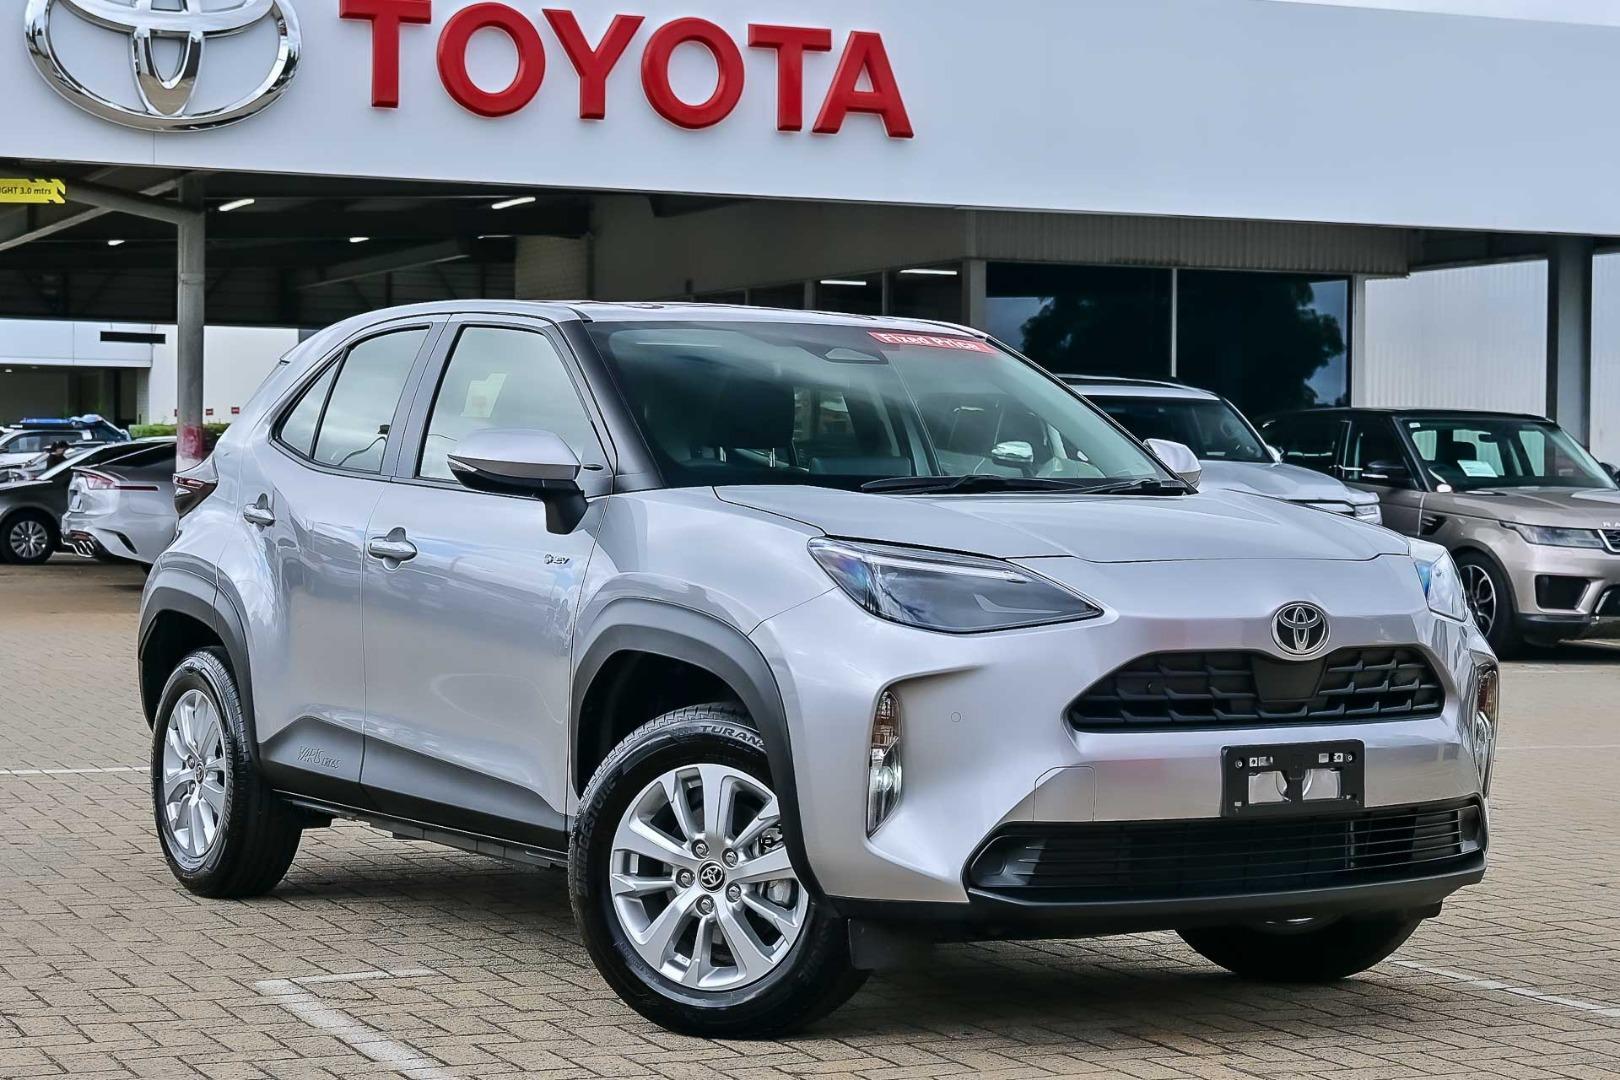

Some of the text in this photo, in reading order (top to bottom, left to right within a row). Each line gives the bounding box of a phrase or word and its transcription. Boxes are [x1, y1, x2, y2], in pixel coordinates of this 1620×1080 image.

[340, 0, 914, 138] TOYOTA
[20, 186, 32, 195] 3.0
[33, 187, 52, 195] mtrs
